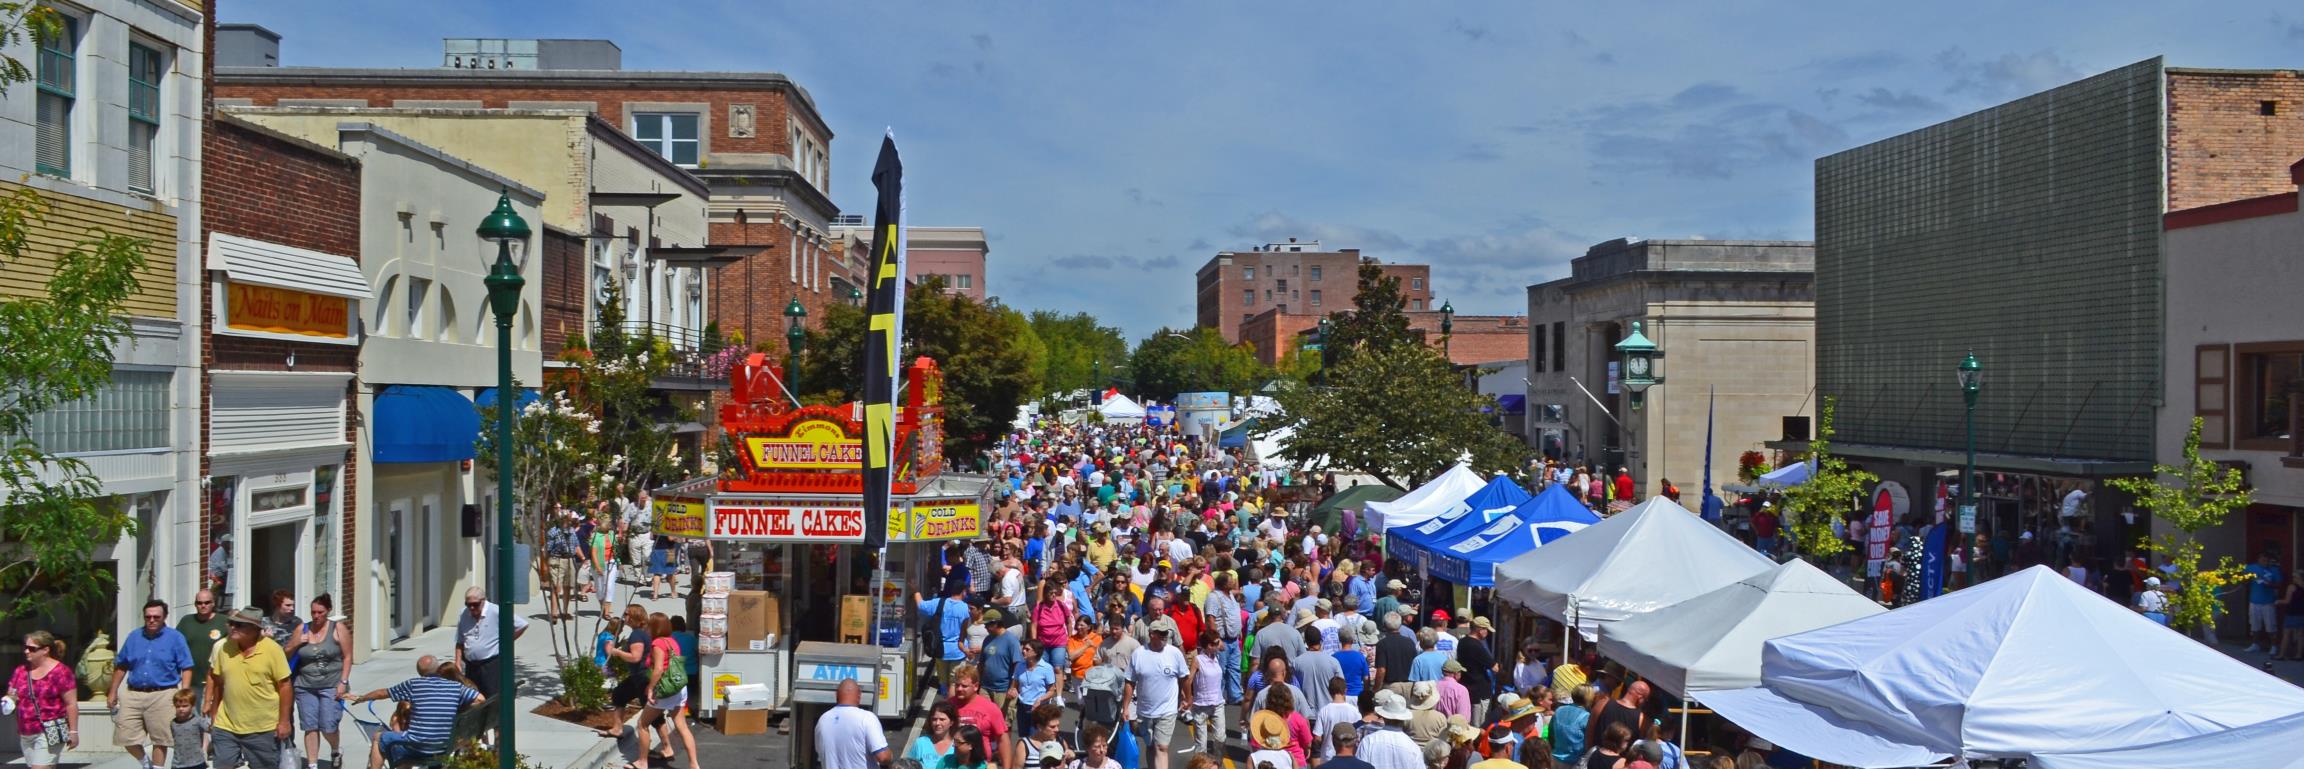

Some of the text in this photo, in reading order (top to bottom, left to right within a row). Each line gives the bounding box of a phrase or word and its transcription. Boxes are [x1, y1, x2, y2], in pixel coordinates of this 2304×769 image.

[235, 286, 344, 326] Nails on Main
[762, 443, 862, 463] FUNNEL CAKE
[714, 508, 794, 535] FUNNEL
[802, 510, 862, 536] CAKES
[931, 508, 956, 518] COLD
[927, 517, 976, 536] DRINKS
[813, 664, 858, 681] ATM
